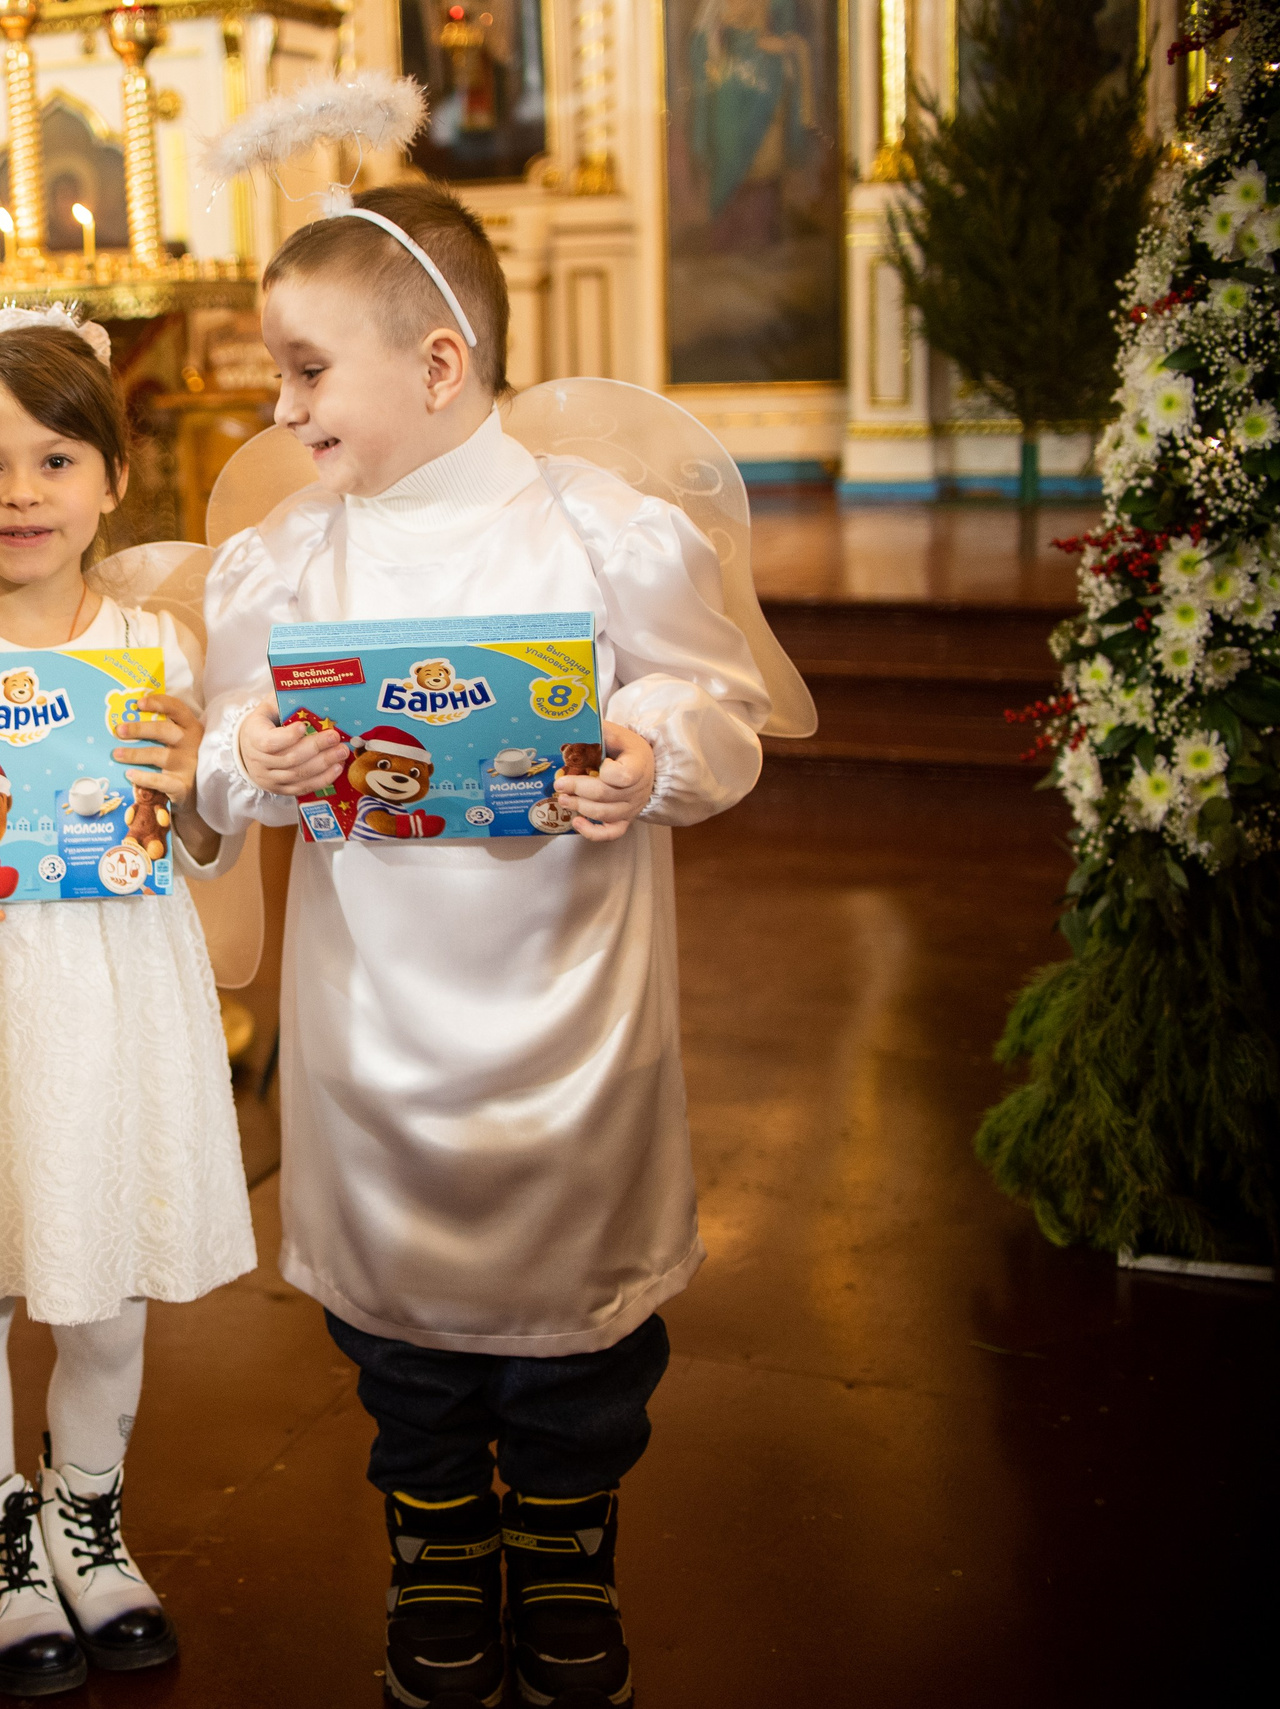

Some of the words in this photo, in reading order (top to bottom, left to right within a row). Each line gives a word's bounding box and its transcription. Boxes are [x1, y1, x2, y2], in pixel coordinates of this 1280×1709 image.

[122, 652, 161, 688] Выгодная
[546, 644, 591, 676] Выгодная
[292, 668, 336, 678] Весёлых
[381, 681, 491, 713] Барни
[547, 684, 572, 707] 8
[121, 699, 142, 722] 8
[475, 810, 484, 820] 3
[48, 862, 57, 873] 3
